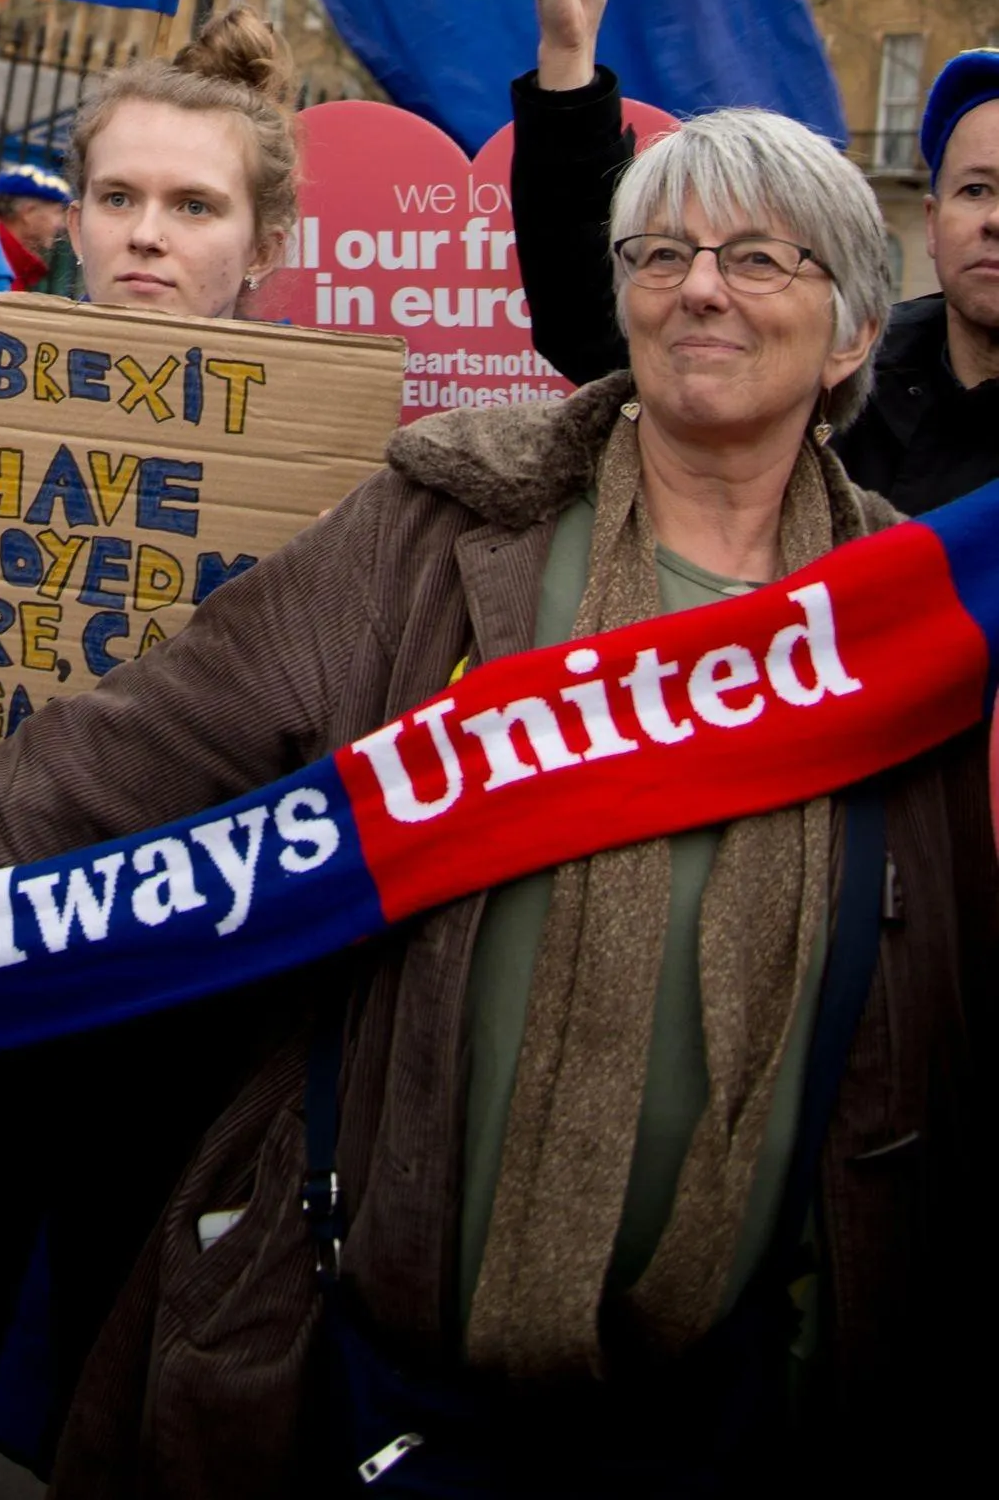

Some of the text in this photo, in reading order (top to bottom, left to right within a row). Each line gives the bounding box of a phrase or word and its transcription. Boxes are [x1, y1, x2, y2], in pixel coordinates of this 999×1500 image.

[394, 184, 456, 214] we
[334, 229, 450, 270] our
[316, 272, 375, 325] in
[351, 581, 863, 824] United
